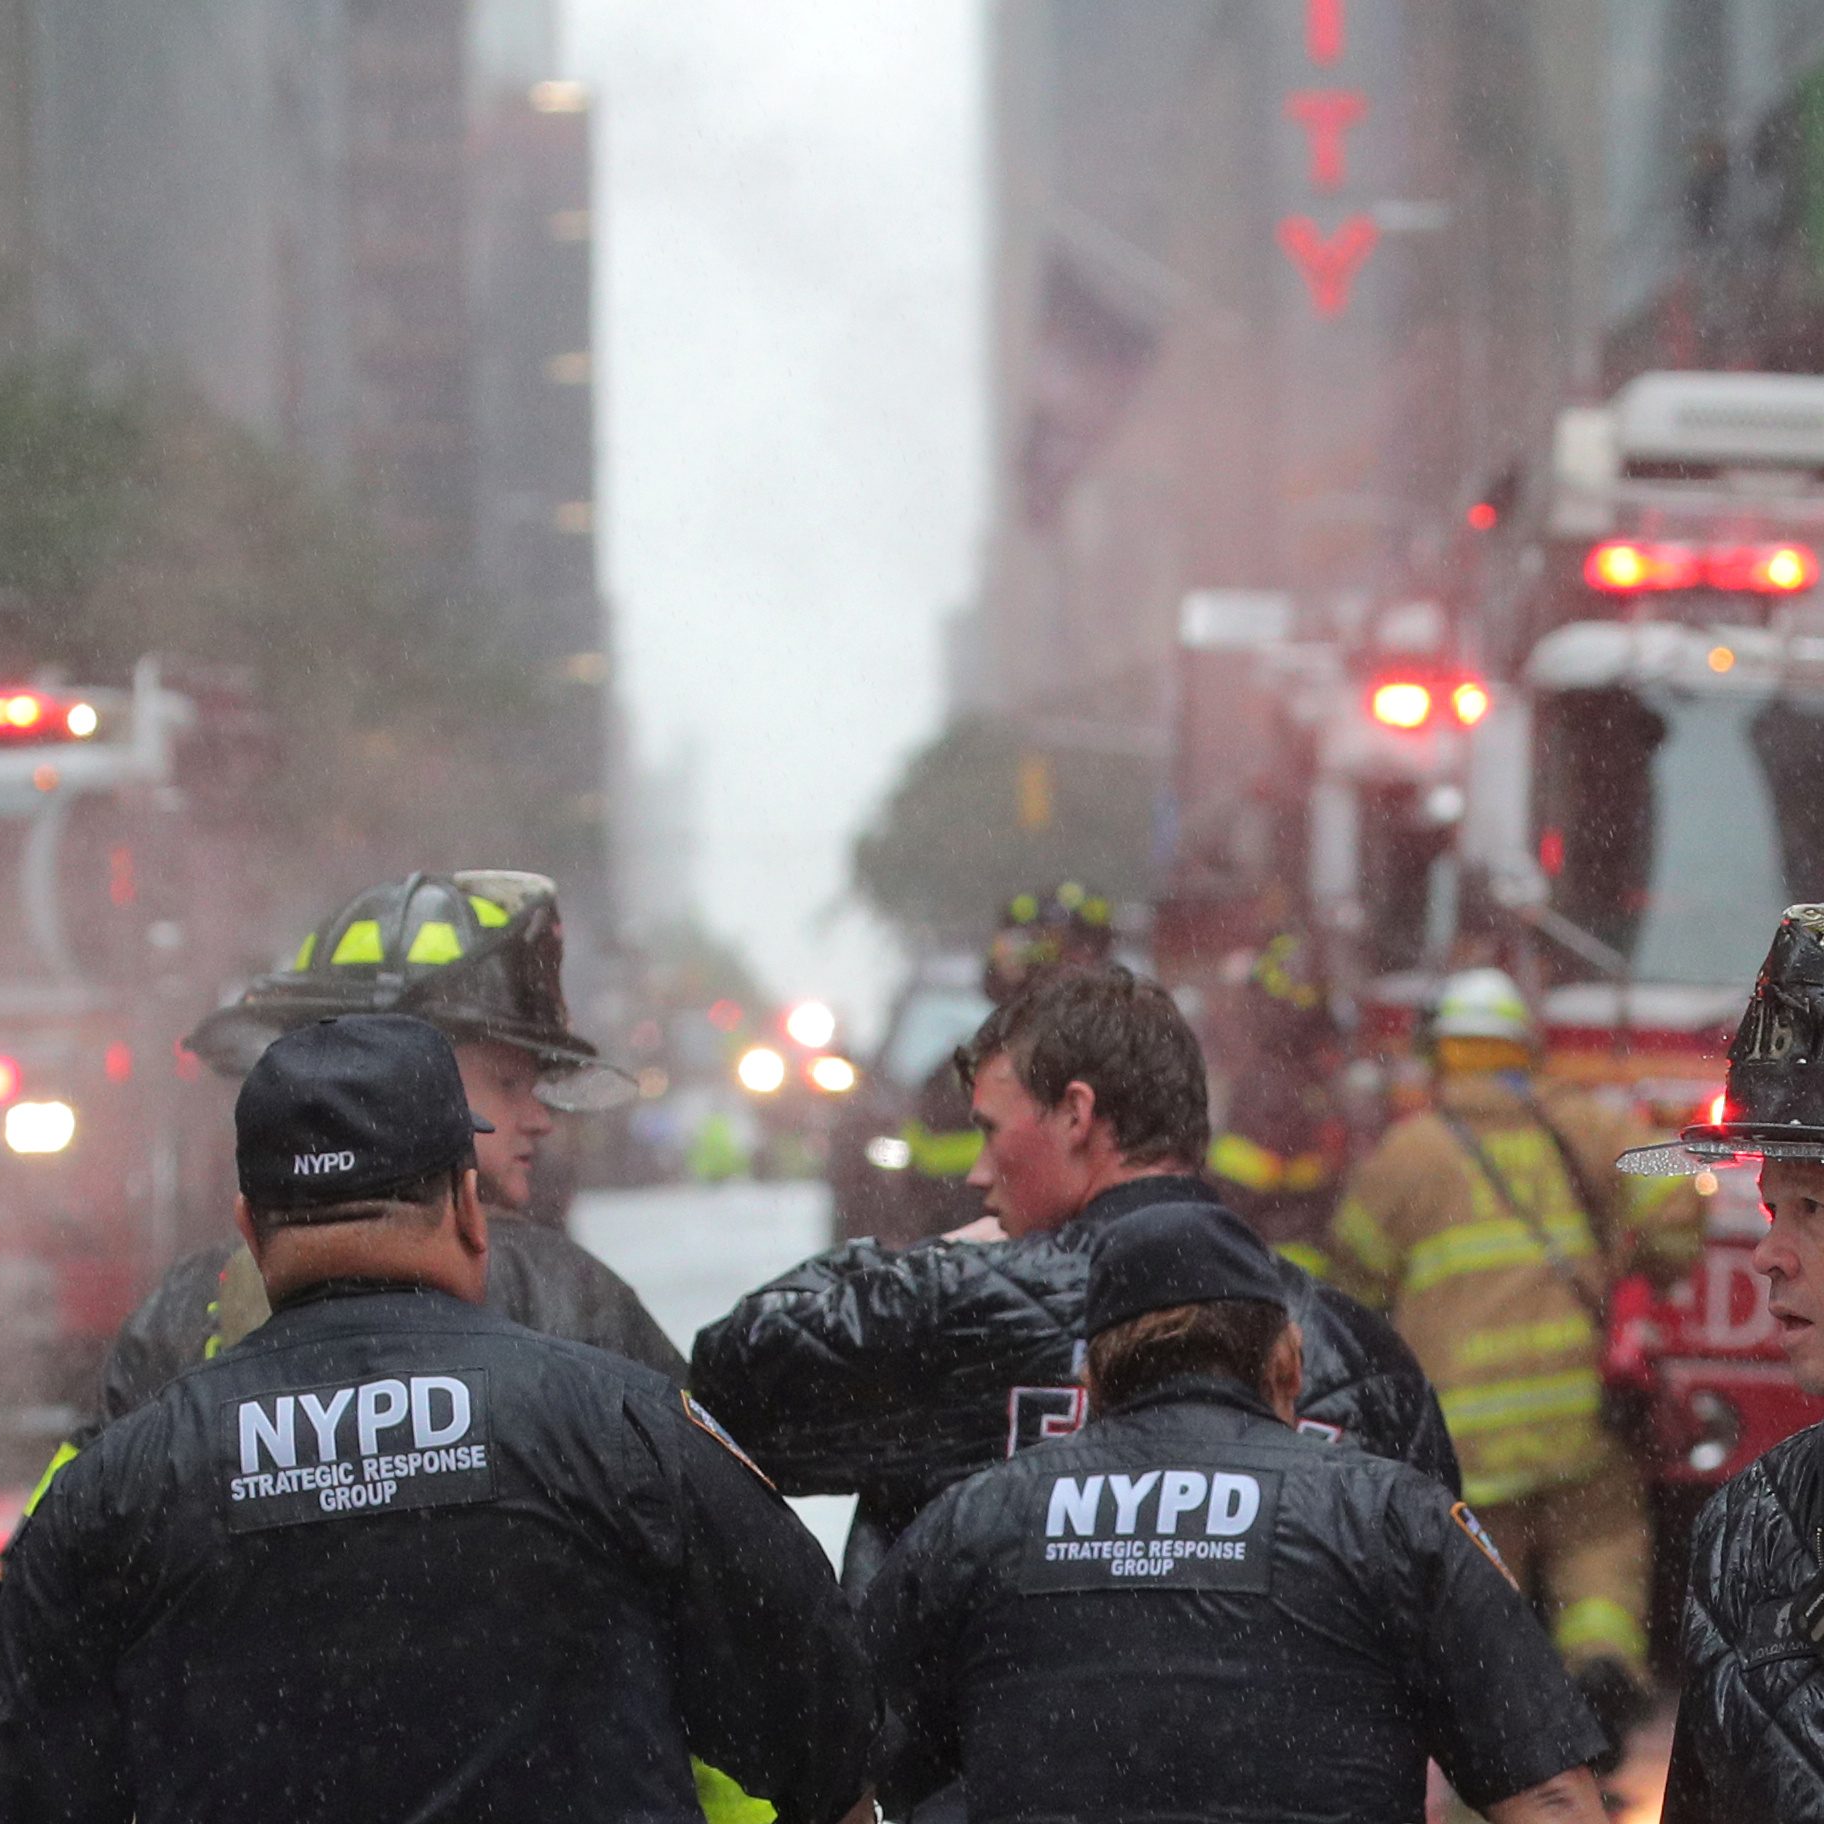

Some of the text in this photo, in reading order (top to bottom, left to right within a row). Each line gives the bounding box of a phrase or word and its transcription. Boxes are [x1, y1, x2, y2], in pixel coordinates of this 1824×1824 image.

[292, 1151, 356, 1175] NYPD
[238, 1375, 473, 1475] NYPD
[231, 1444, 487, 1501] STRATEGIC RESPONSE
[319, 1479, 398, 1513] GROUP
[1044, 1469, 1261, 1536] NYPD
[1044, 1539, 1246, 1562] STRATEGIC RESPONSE
[1110, 1558, 1174, 1577] GROUP
